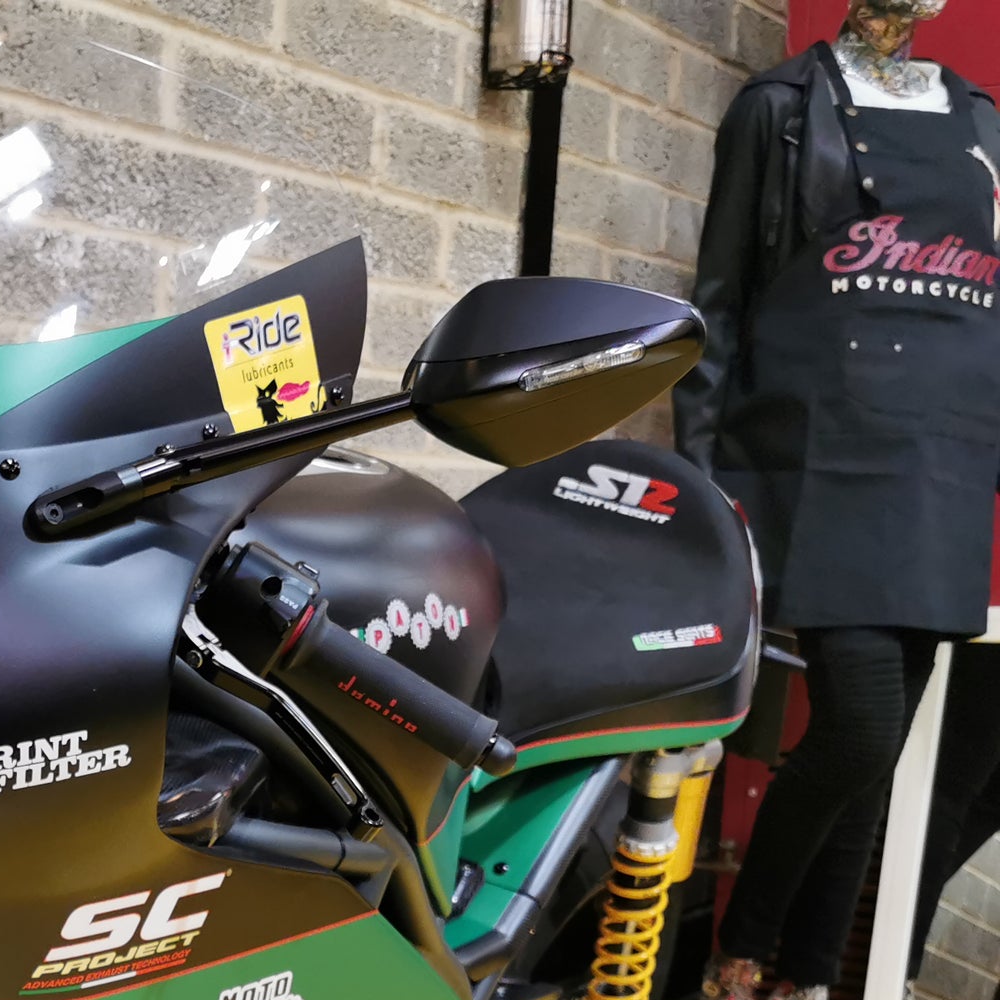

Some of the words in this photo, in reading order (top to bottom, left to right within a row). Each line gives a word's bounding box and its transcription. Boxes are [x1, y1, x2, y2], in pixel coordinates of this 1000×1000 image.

[823, 215, 1000, 286] Indian
[831, 275, 993, 308] MOTORCYCLE
[222, 307, 302, 362] iRide
[242, 357, 294, 383] lubricants
[553, 486, 671, 525] LIGHTWEIGHT
[337, 675, 419, 734] domino
[43, 872, 227, 962] SC
[22, 976, 85, 990] ADVANCED
[85, 964, 131, 983] EXHAUST
[131, 949, 192, 970] TECHNOLOGY
[31, 930, 201, 979] PROJECT
